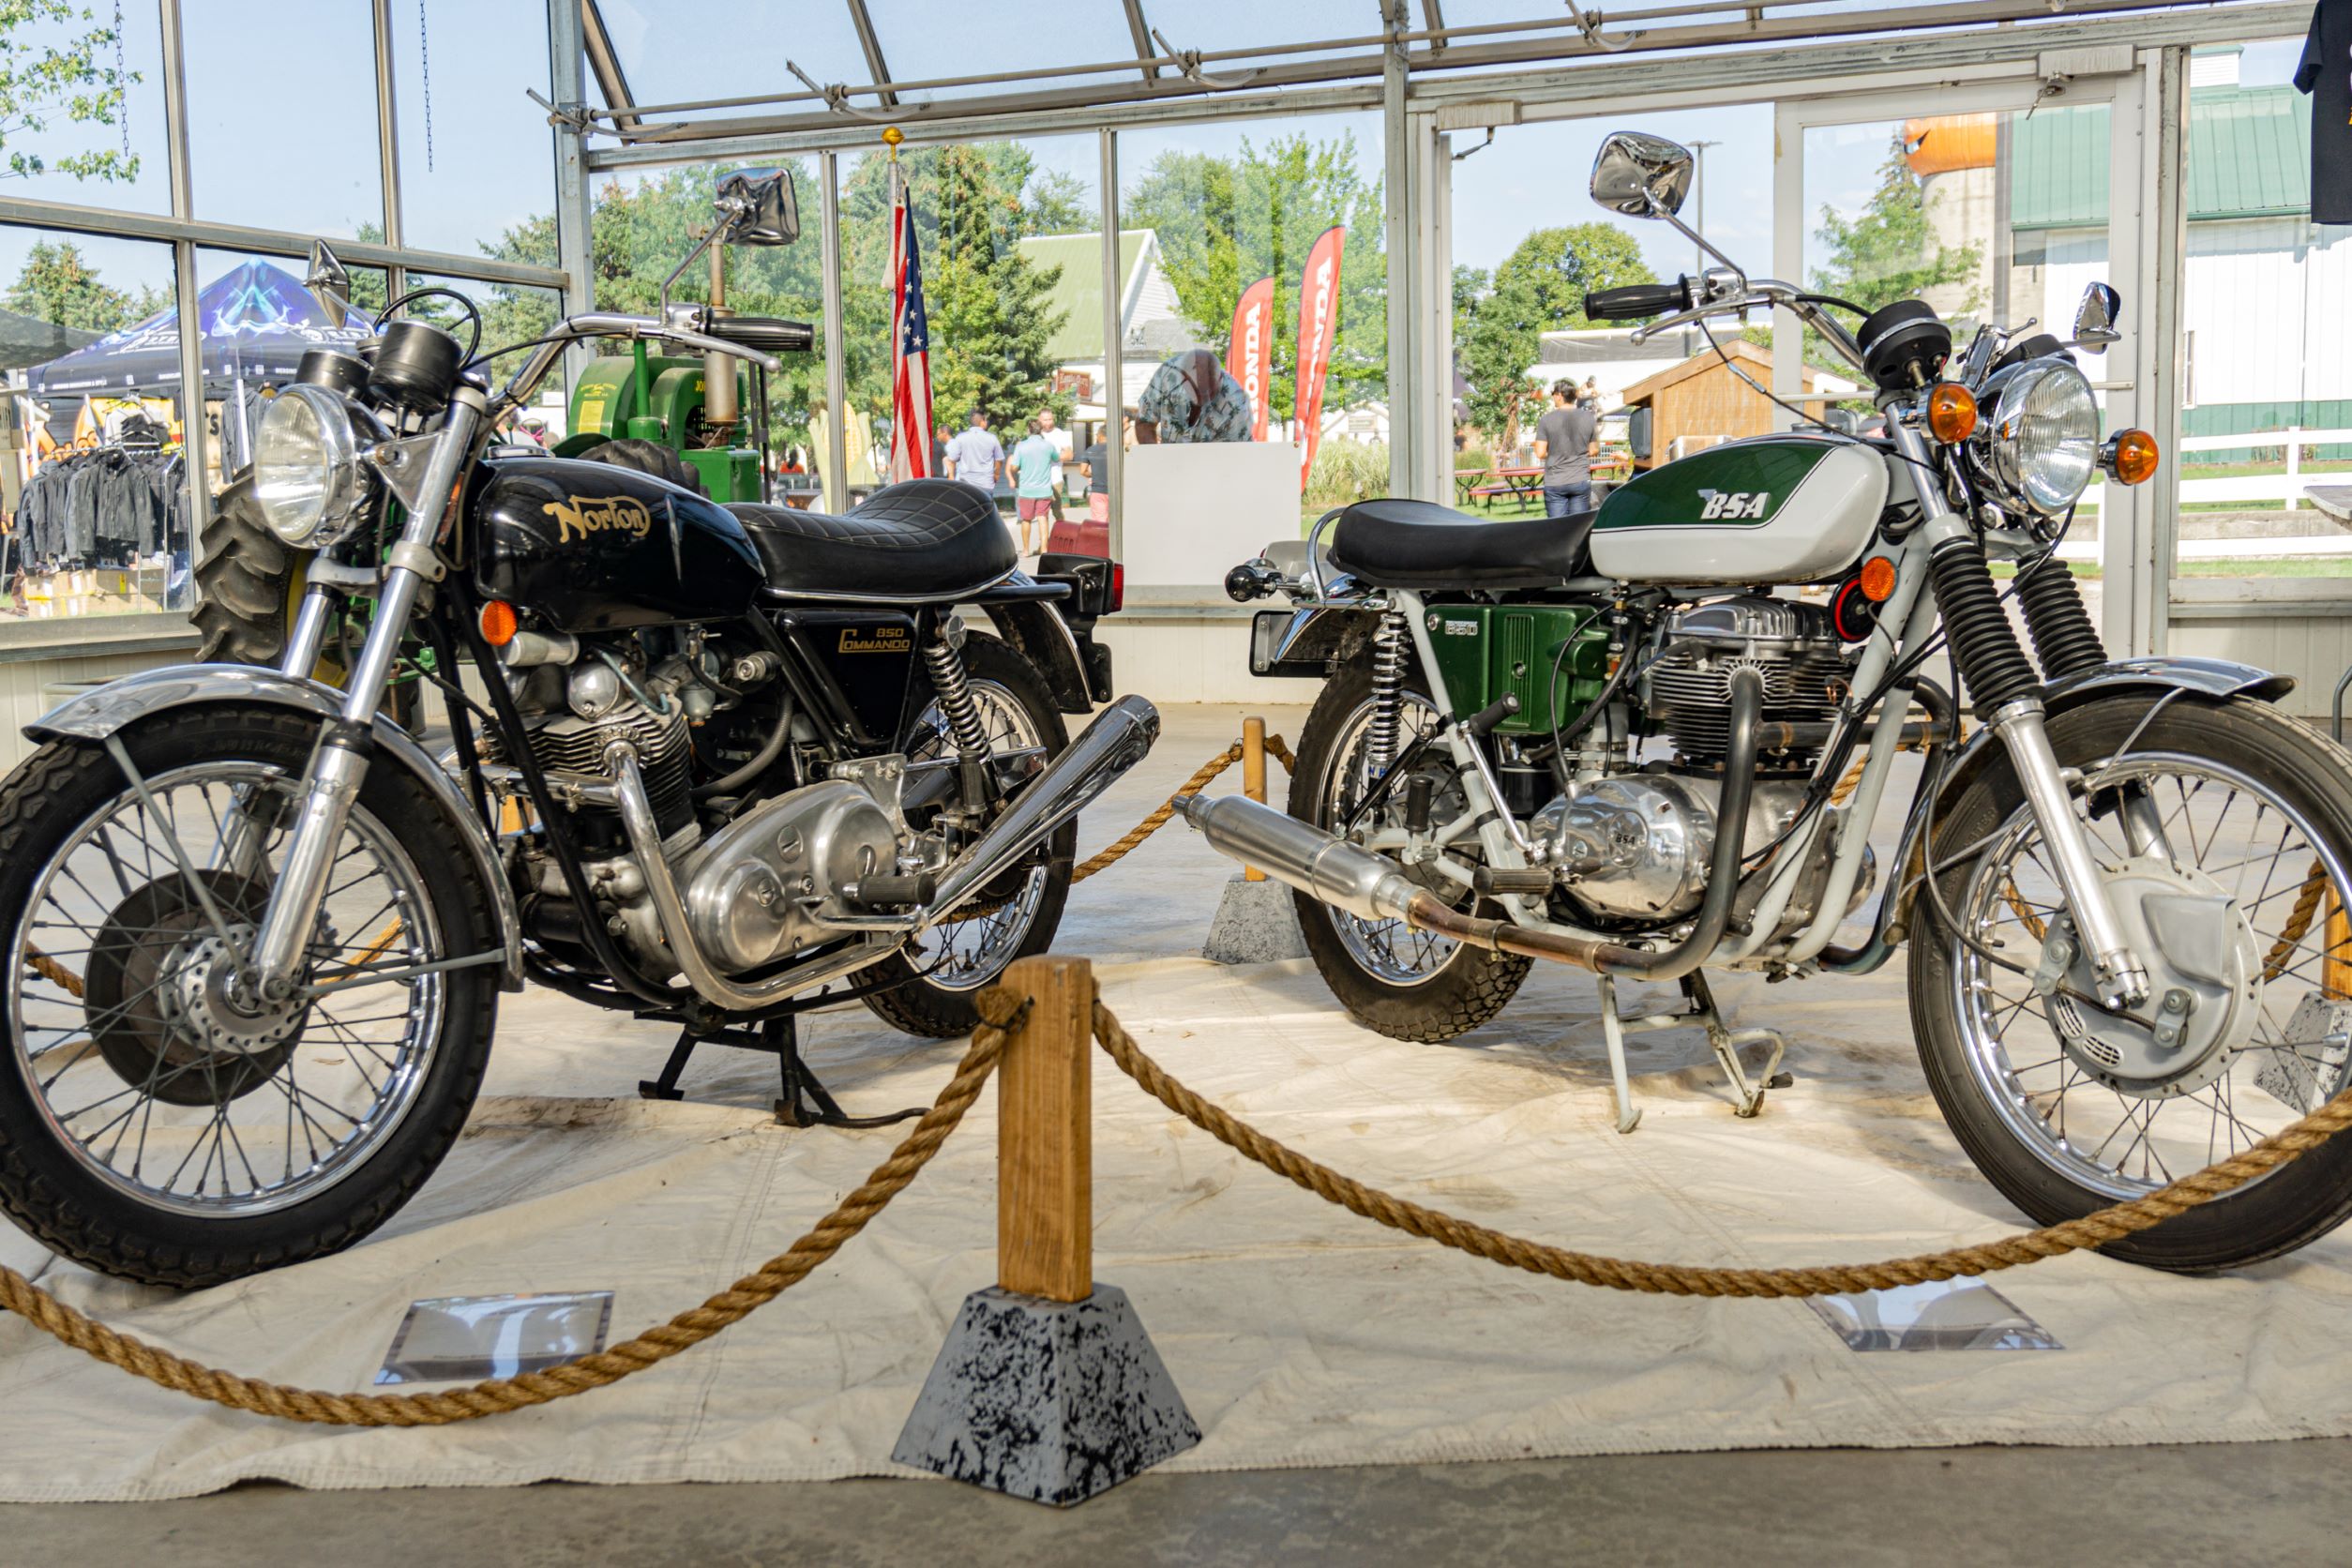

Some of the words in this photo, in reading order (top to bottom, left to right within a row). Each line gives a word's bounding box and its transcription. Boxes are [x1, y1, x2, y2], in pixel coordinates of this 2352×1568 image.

[1699, 491, 1772, 520] BSA
[542, 494, 651, 544] Norton
[838, 628, 911, 654] COMMANDO
[877, 627, 904, 638] 850
[1615, 833, 1636, 845] BSA
